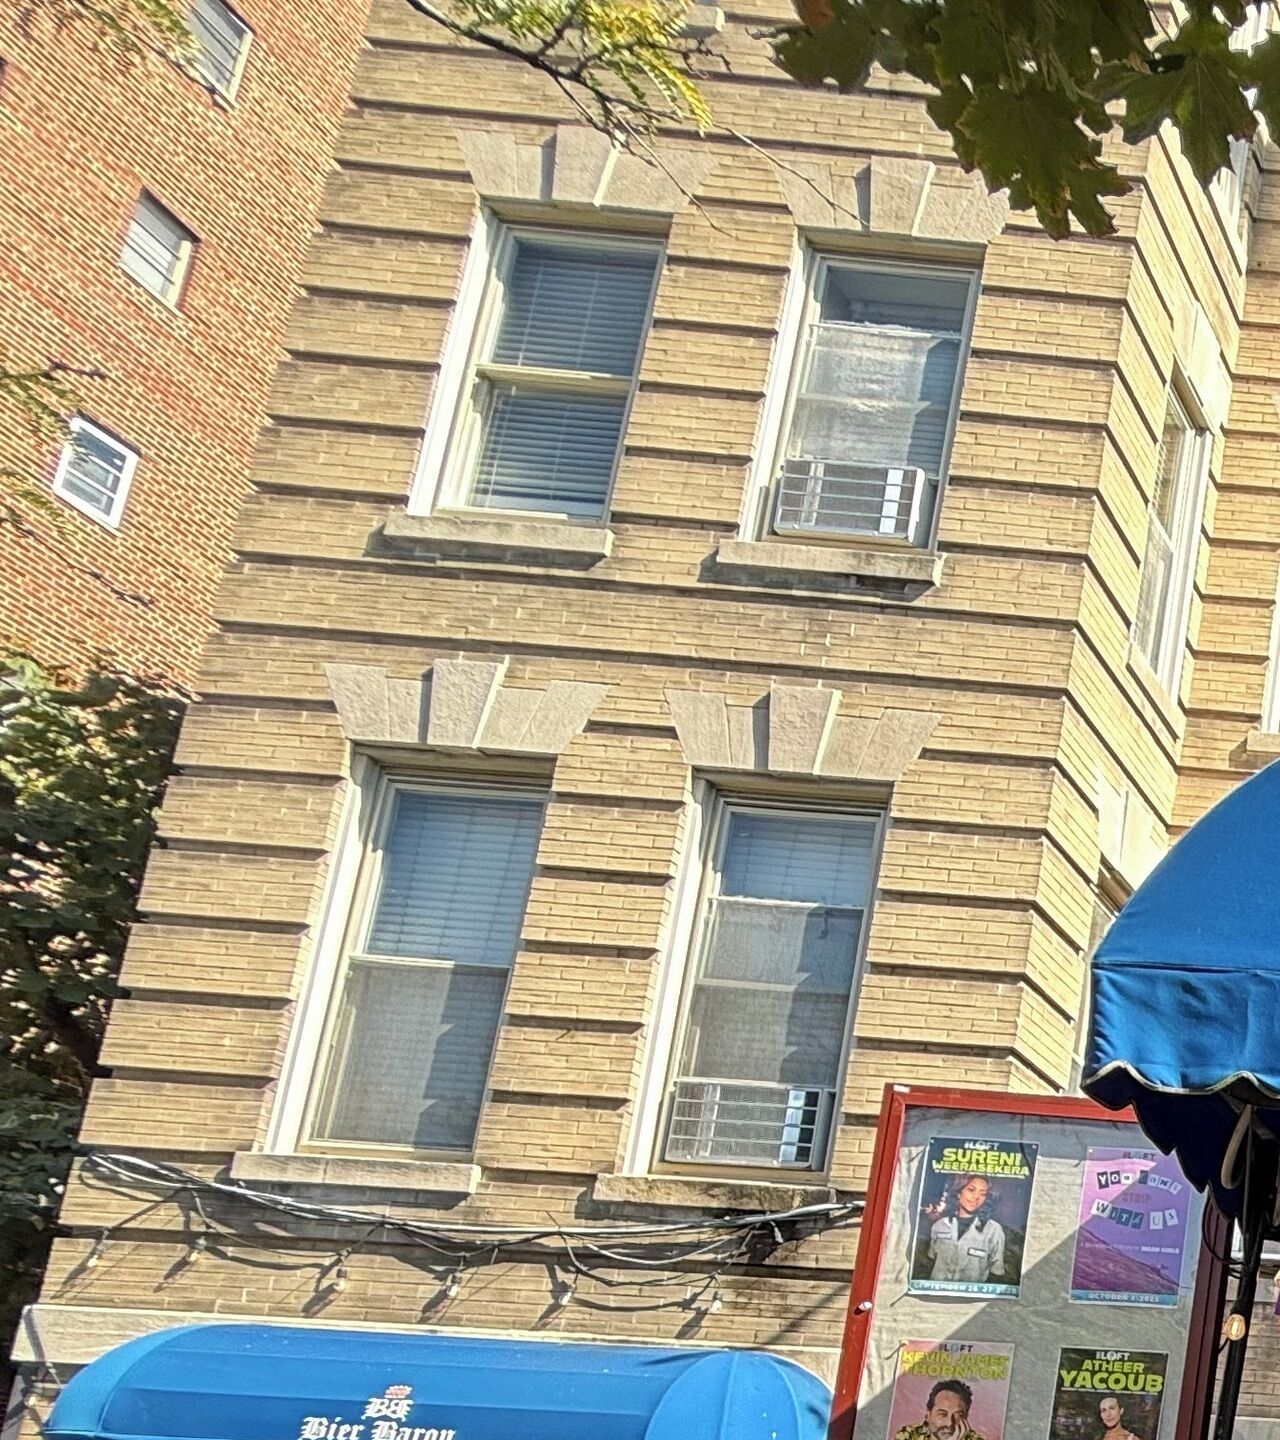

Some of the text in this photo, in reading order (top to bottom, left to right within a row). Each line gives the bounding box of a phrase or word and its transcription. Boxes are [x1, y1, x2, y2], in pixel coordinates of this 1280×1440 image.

[943, 1148, 1022, 1166] SURENI
[932, 1160, 1030, 1176] WEERASEKERA
[1081, 1360, 1145, 1373] ATHEER
[1060, 1370, 1163, 1392] YACOUB
